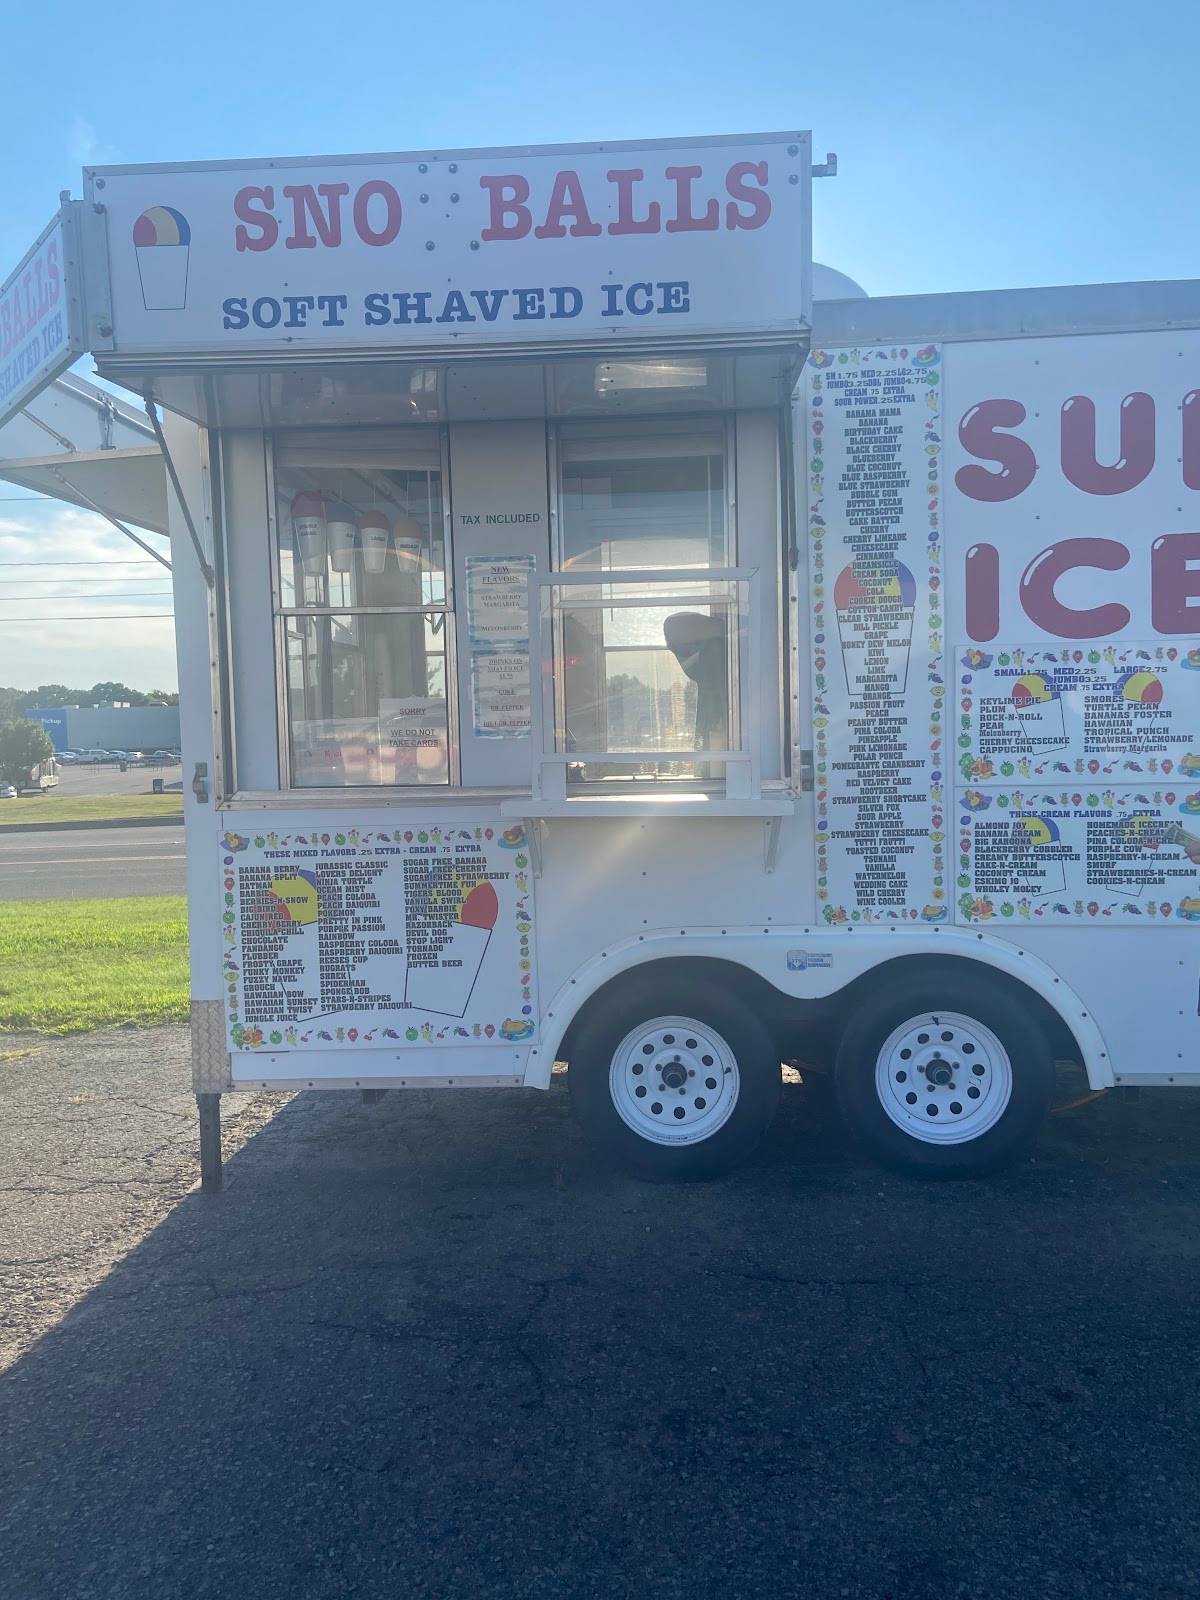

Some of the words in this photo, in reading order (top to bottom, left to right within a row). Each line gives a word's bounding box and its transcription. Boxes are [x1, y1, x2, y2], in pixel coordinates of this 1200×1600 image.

[234, 180, 402, 252] SNO
[479, 161, 772, 241] BALLS
[222, 295, 347, 329] SOFT
[364, 286, 584, 325] SHAVED
[600, 281, 690, 317] ICE
[879, 408, 901, 416] MAMA
[845, 428, 881, 436] BIRTHDAY
[955, 389, 1200, 502] SU
[853, 454, 895, 463] BLUEBERRY
[851, 491, 879, 499] BUBBLE
[846, 507, 903, 517] BUTTERSCOTCH
[461, 515, 480, 524] TAX
[486, 513, 540, 524] INCLUDED
[844, 535, 871, 543] CHERRY
[875, 534, 907, 542] LIMEADE
[482, 576, 520, 584] FLAVORS
[873, 622, 898, 630] PICKLE
[856, 675, 897, 683] MARGARITA
[1084, 745, 1126, 753] Strawberry
[1130, 744, 1167, 752] Margarita
[861, 787, 897, 795] ROOTBEER
[406, 921, 452, 929] RAZORBACK
